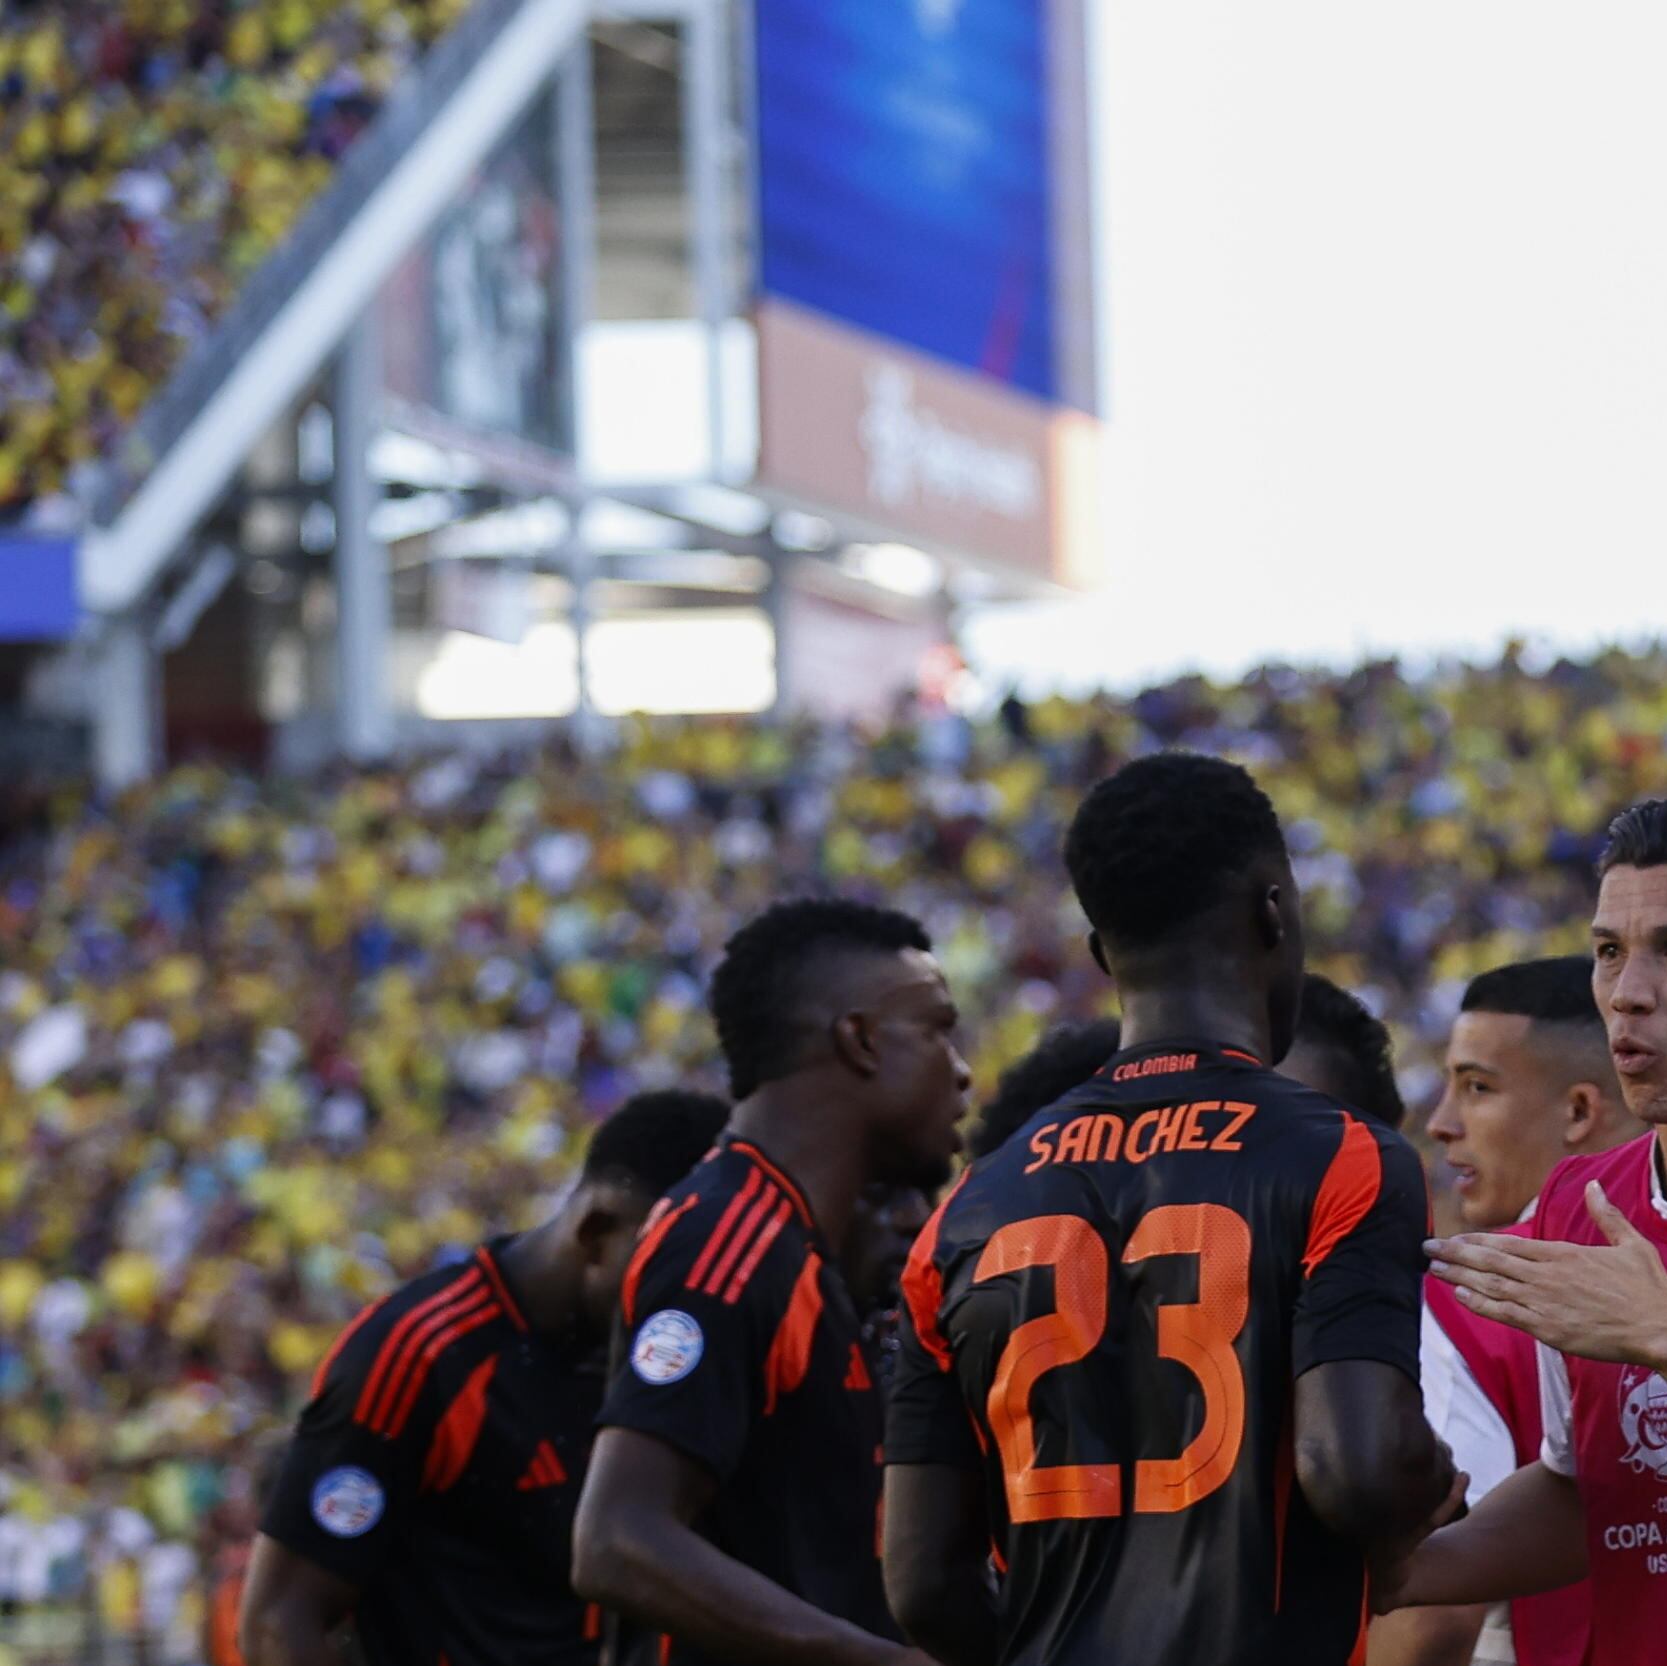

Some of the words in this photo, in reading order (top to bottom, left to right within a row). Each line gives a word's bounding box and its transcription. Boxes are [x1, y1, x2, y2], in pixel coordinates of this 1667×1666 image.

[1112, 1053, 1199, 1082] COLOMBIA
[1024, 1101, 1258, 1174] SANCHEZ
[973, 1203, 1251, 1524] 23
[1604, 1521, 1663, 1550] COPA
